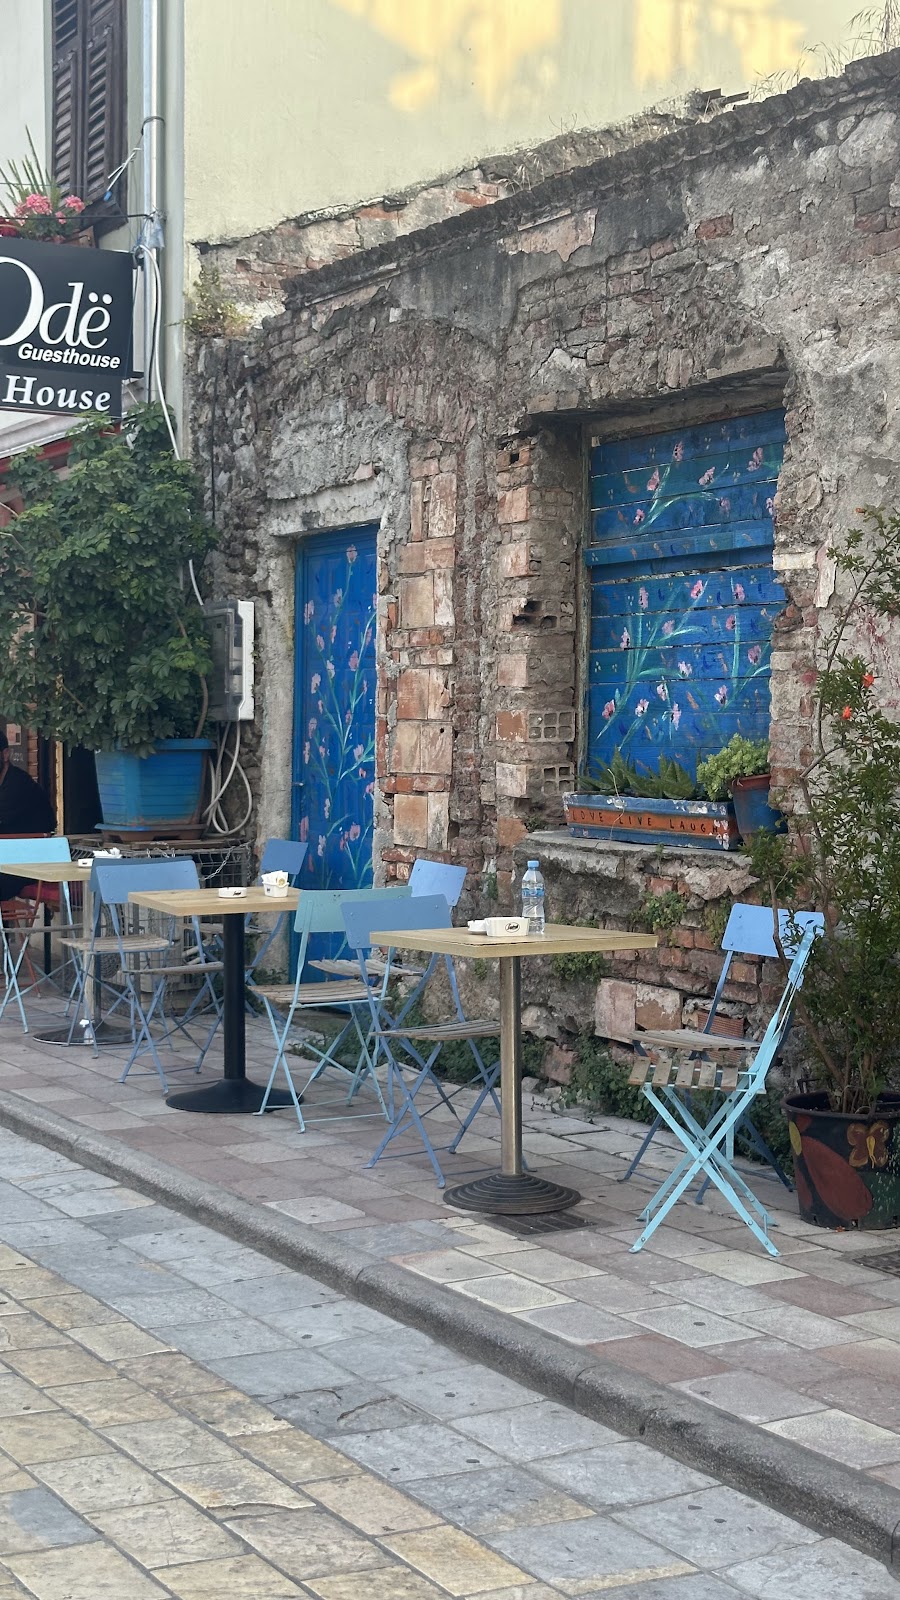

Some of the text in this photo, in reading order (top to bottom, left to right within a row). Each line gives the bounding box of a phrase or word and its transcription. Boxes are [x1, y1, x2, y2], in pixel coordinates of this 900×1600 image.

[18, 343, 121, 369] Guesthouse
[2, 374, 111, 411] House
[572, 810, 718, 834] LOVE LIVE LAUGH
